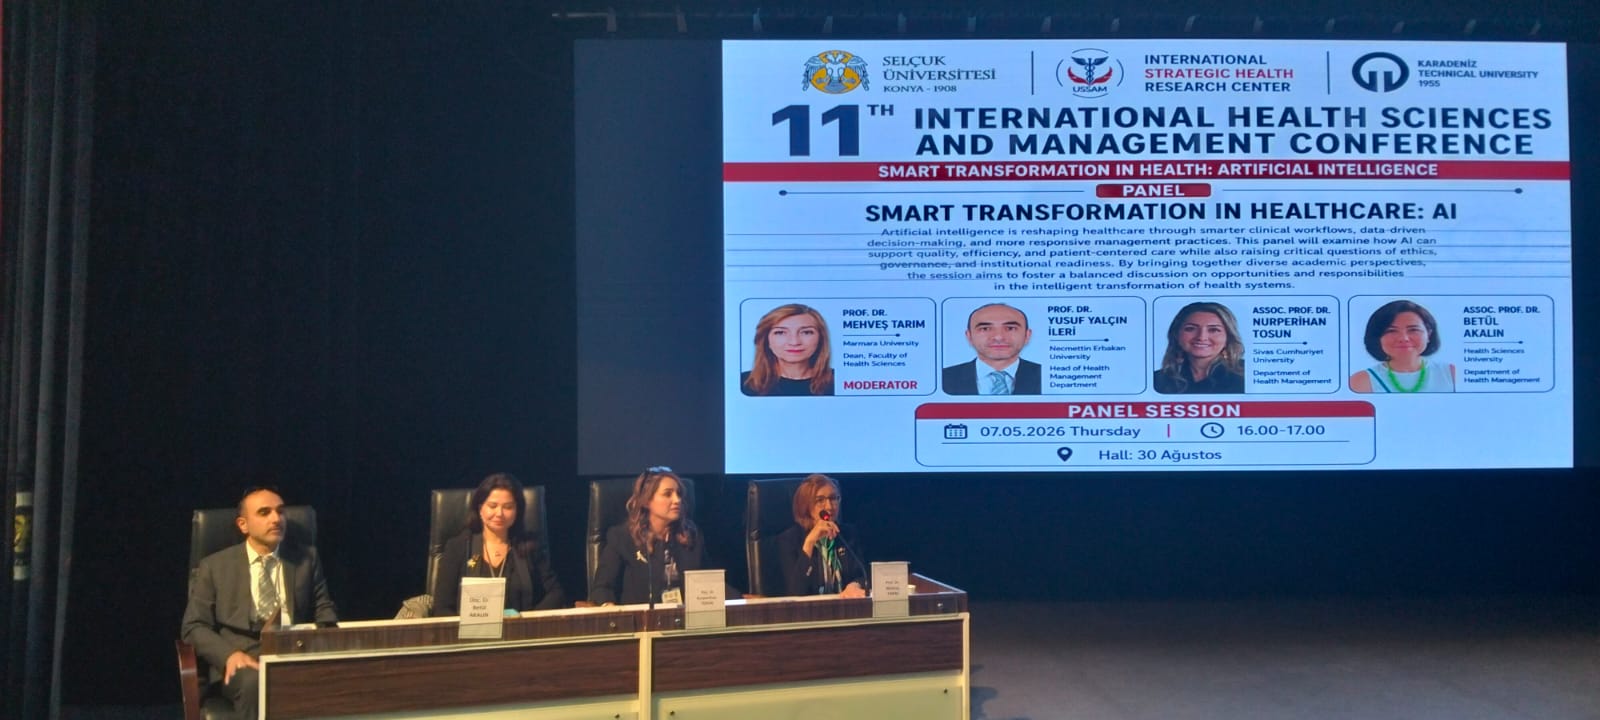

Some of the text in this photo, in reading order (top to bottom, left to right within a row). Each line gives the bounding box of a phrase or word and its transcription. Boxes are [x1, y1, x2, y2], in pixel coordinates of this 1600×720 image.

[882, 55, 946, 68] SELÇUK
[1144, 54, 1267, 65] INTERNATIONAL
[1417, 58, 1477, 68] KARADENİZ
[883, 68, 996, 81] ÜNİVERSİTESİ
[1145, 68, 1293, 78] STRATEGIC HEALTH
[1418, 69, 1538, 78] TECHNICAL UNIVERSITY
[934, 84, 957, 92] 1908
[1072, 84, 1107, 92] USSAM
[1145, 81, 1290, 92] RESEARCH CENTER
[1418, 79, 1440, 87] 1955
[915, 105, 1551, 129] INTERNATIONAL HEALTH SCIENCES
[915, 132, 1533, 155] AND MANAGEMENT CONFERENCE
[878, 162, 1438, 177] SMART TRANSFORMATION IN HEALTH: ARTIFICIAL INTELLIGENCE
[1123, 184, 1184, 196] PANEL
[865, 202, 1456, 222] SMART TRANSFORMATION IN HEALTHCARE: AI
[880, 228, 932, 236] Artificial
[935, 227, 1004, 237] intelligence
[1008, 227, 1017, 235] is
[1021, 227, 1078, 237] reshaping
[1082, 226, 1144, 235] healthcare
[1149, 226, 1196, 236] through
[1200, 226, 1245, 234] smarter
[1248, 225, 1290, 233] clinical
[1359, 225, 1426, 234] data-driven
[867, 239, 966, 249] decision-making,
[969, 238, 991, 247] and
[1029, 238, 1091, 248] responsive
[1094, 238, 1170, 248] management
[1174, 238, 1231, 248] practices.
[1235, 237, 1259, 246] This
[1262, 237, 1294, 248] panel
[1299, 237, 1318, 245] will
[1323, 237, 1369, 245] examine
[1373, 237, 1397, 245] how
[1400, 237, 1414, 245] AI
[868, 250, 912, 260] support
[916, 250, 958, 259] quality,
[963, 249, 1021, 259] efficiency,
[1023, 249, 1046, 257] and
[1049, 249, 1147, 259] patient-centered
[1179, 249, 1210, 257] while
[1241, 248, 1280, 258] raising
[1283, 248, 1323, 256] critical
[1326, 248, 1381, 258] questions
[1385, 248, 1396, 256] of
[954, 260, 976, 268] and
[980, 260, 1051, 268] institutional
[1118, 259, 1133, 269] By
[1137, 259, 1187, 269] bringing
[1191, 259, 1241, 269] together
[1246, 259, 1287, 267] diverse
[1291, 259, 1346, 267] academic
[1350, 258, 1426, 268] perspectives,
[907, 271, 926, 280] the
[929, 271, 974, 279] session
[975, 271, 1002, 279] aims
[1006, 271, 1018, 279] to
[1022, 270, 1055, 279] foster
[1069, 270, 1122, 278] balanced
[1126, 270, 1188, 278] discussion
[1210, 269, 1290, 279] opportunities
[1293, 269, 1315, 277] and
[1318, 268, 1404, 279] responsibilities
[994, 280, 1294, 291] in the intelligent transformation of health systems.
[842, 319, 925, 330] MEHVEŞ TARIM
[1047, 316, 1127, 326] YUSUF YALÇIN
[1252, 315, 1326, 326] NURPERİHAN
[1463, 315, 1498, 325] BETÜL
[1048, 325, 1075, 336] İLERİ
[1252, 329, 1291, 338] TOSUN
[1463, 328, 1504, 337] AKALIN
[868, 352, 897, 360] Faculty
[1275, 347, 1323, 356] Cumhuriyet
[1049, 353, 1090, 361] University
[1252, 356, 1295, 365] University
[1049, 373, 1102, 381] Management
[1253, 369, 1300, 377] Department
[1463, 368, 1510, 376] Department
[843, 380, 917, 390] MODERATOR
[1049, 381, 1097, 389] Department
[1280, 377, 1331, 386] Management
[1490, 376, 1540, 384] Management
[1068, 403, 1241, 418] PANEL SESSION
[980, 425, 1140, 439] 07.05.2026 Thursday
[1099, 449, 1222, 462] Hall: 30 Ağustos
